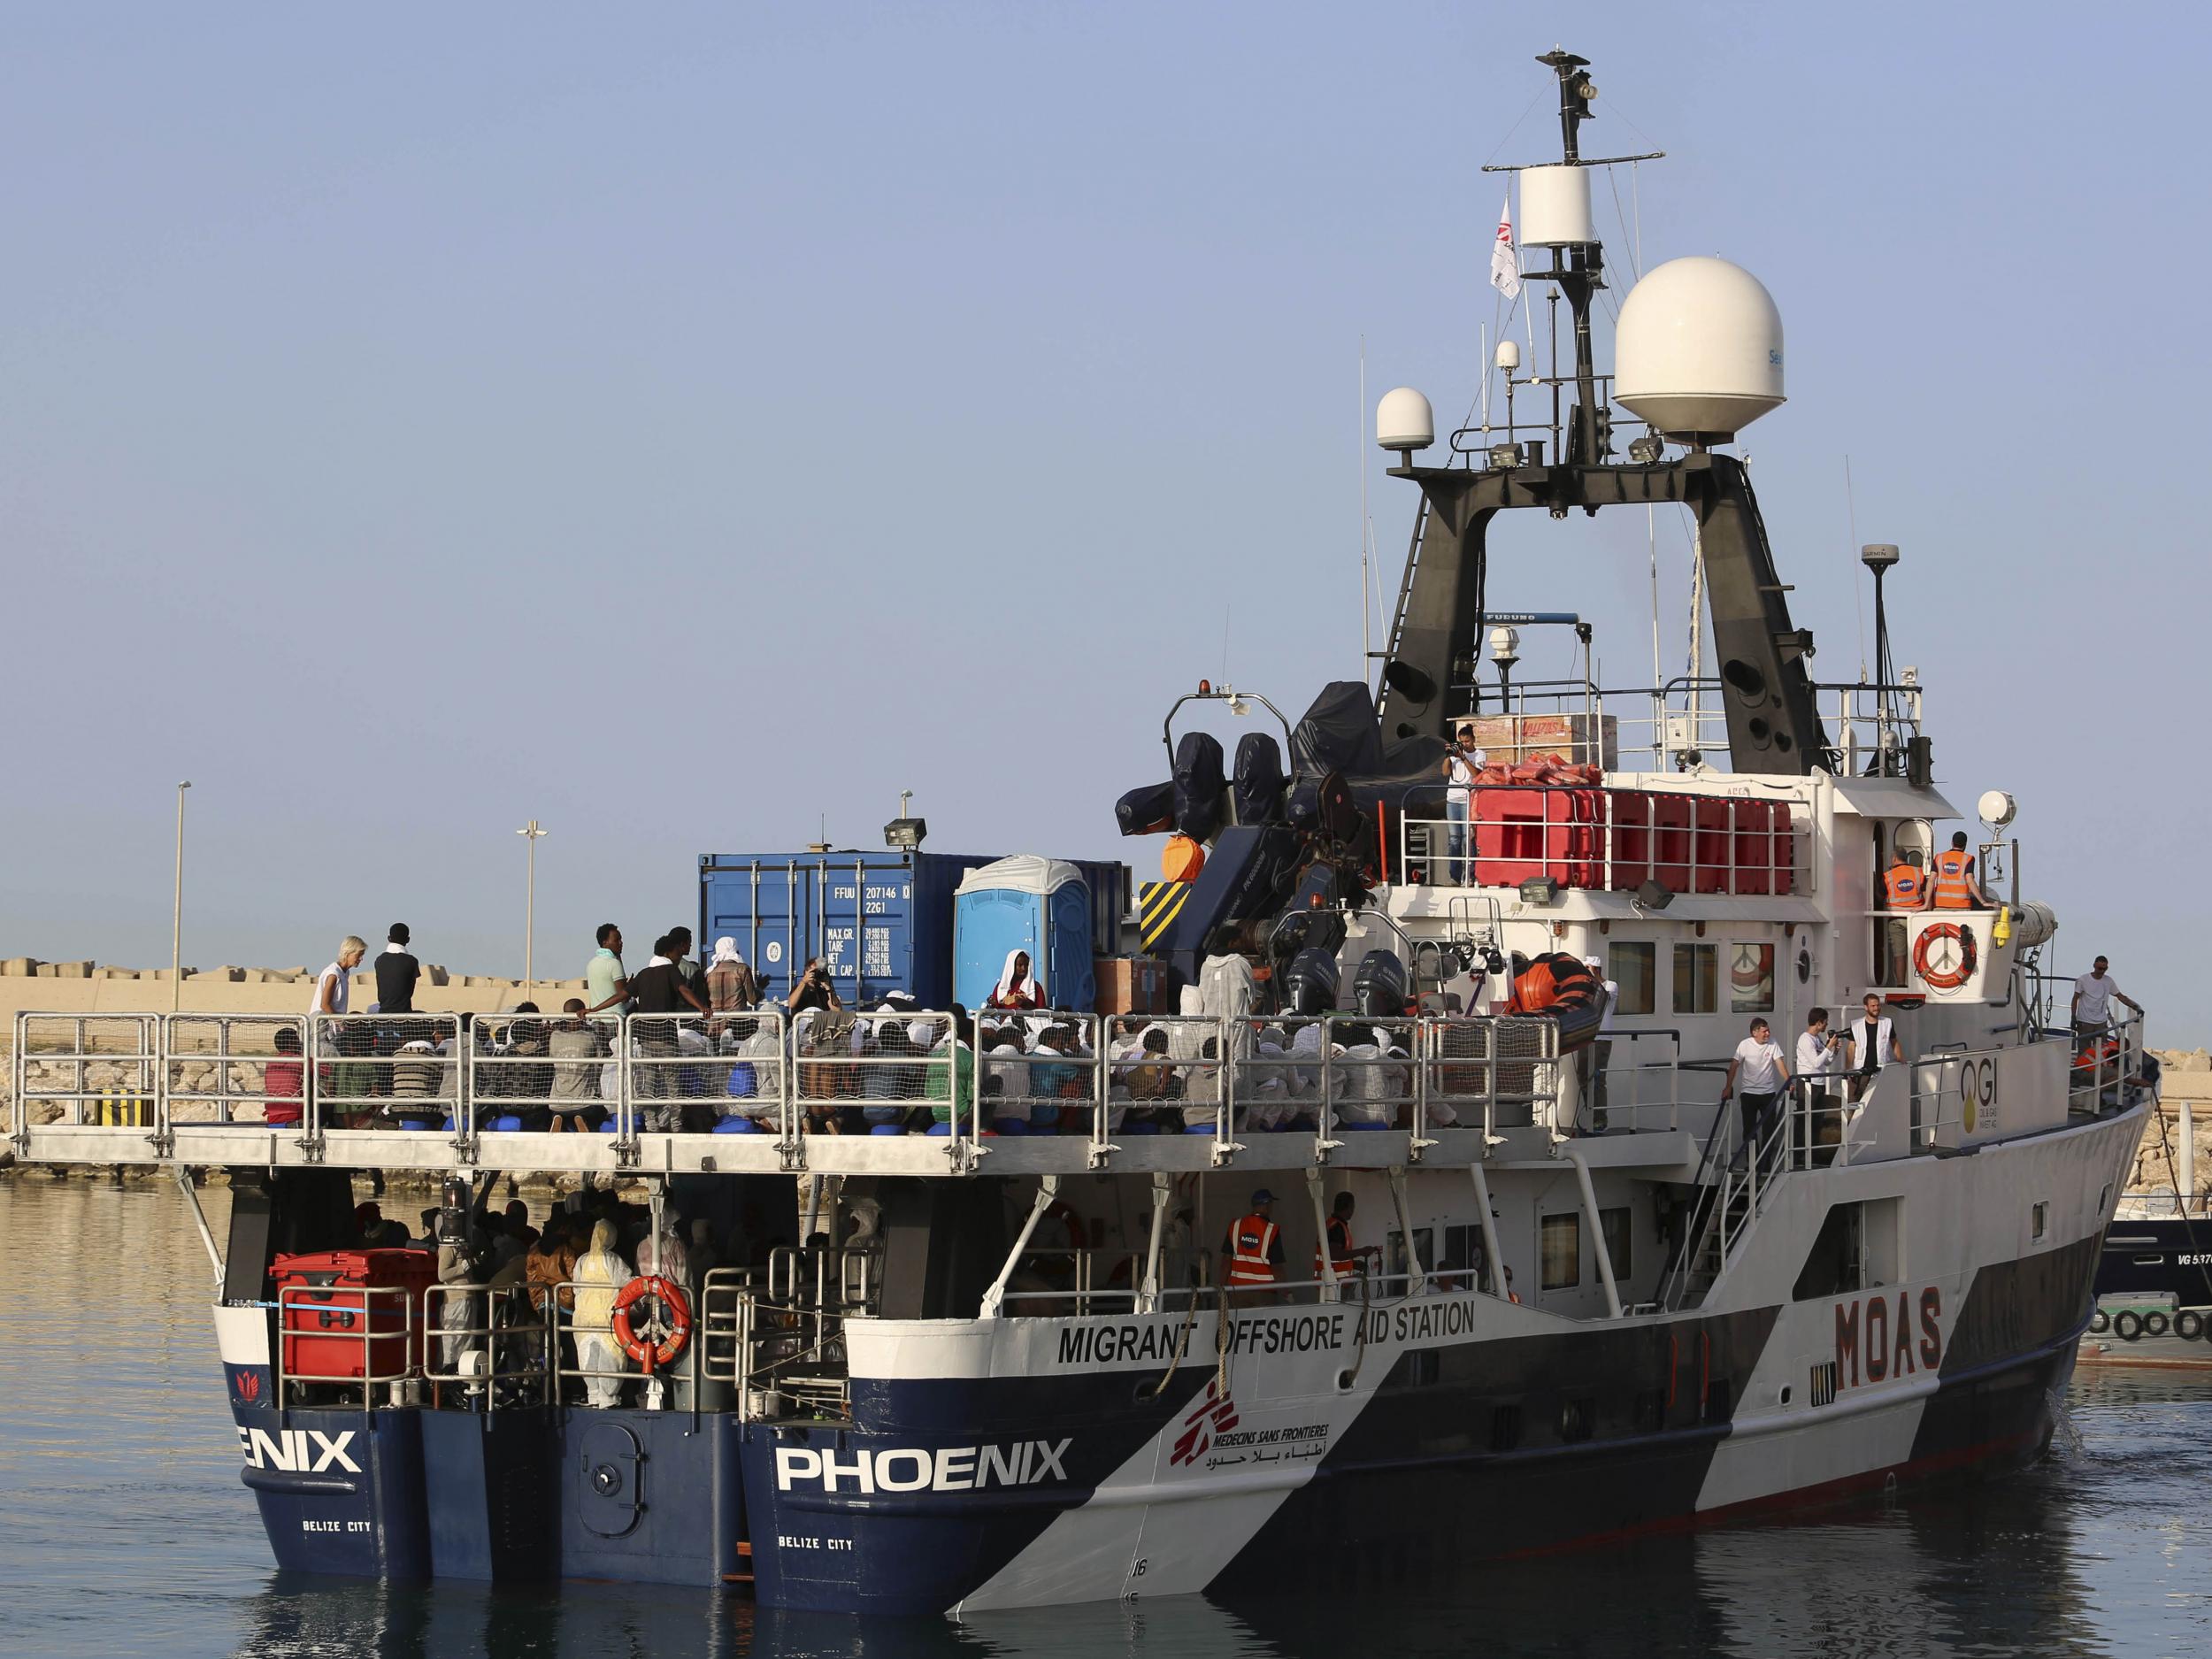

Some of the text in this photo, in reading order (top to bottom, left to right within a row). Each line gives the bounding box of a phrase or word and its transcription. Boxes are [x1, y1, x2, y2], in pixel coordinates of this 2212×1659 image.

[834, 886, 910, 899] FFUU 207146 0
[865, 902, 885, 914] 22G1
[827, 928, 855, 940] MAX.GR.
[828, 941, 844, 952] TARE
[827, 953, 839, 964] NET
[841, 965, 855, 977] CAP.
[1961, 1057, 1997, 1107] OGI
[2178, 1254, 2212, 1265] VG 537
[1058, 1300, 1475, 1363] MIGRANT OFFSHORE AID STATION
[1835, 1286, 1941, 1392] MOAS
[1212, 1424, 1329, 1448] MEDECINS SANS FRONTIERES
[775, 1438, 1073, 1494] PHOENIX
[303, 1520, 371, 1532] BELIZE CITY
[779, 1536, 852, 1551] BELIZE CITY
[1132, 1558, 1148, 1578] 16
